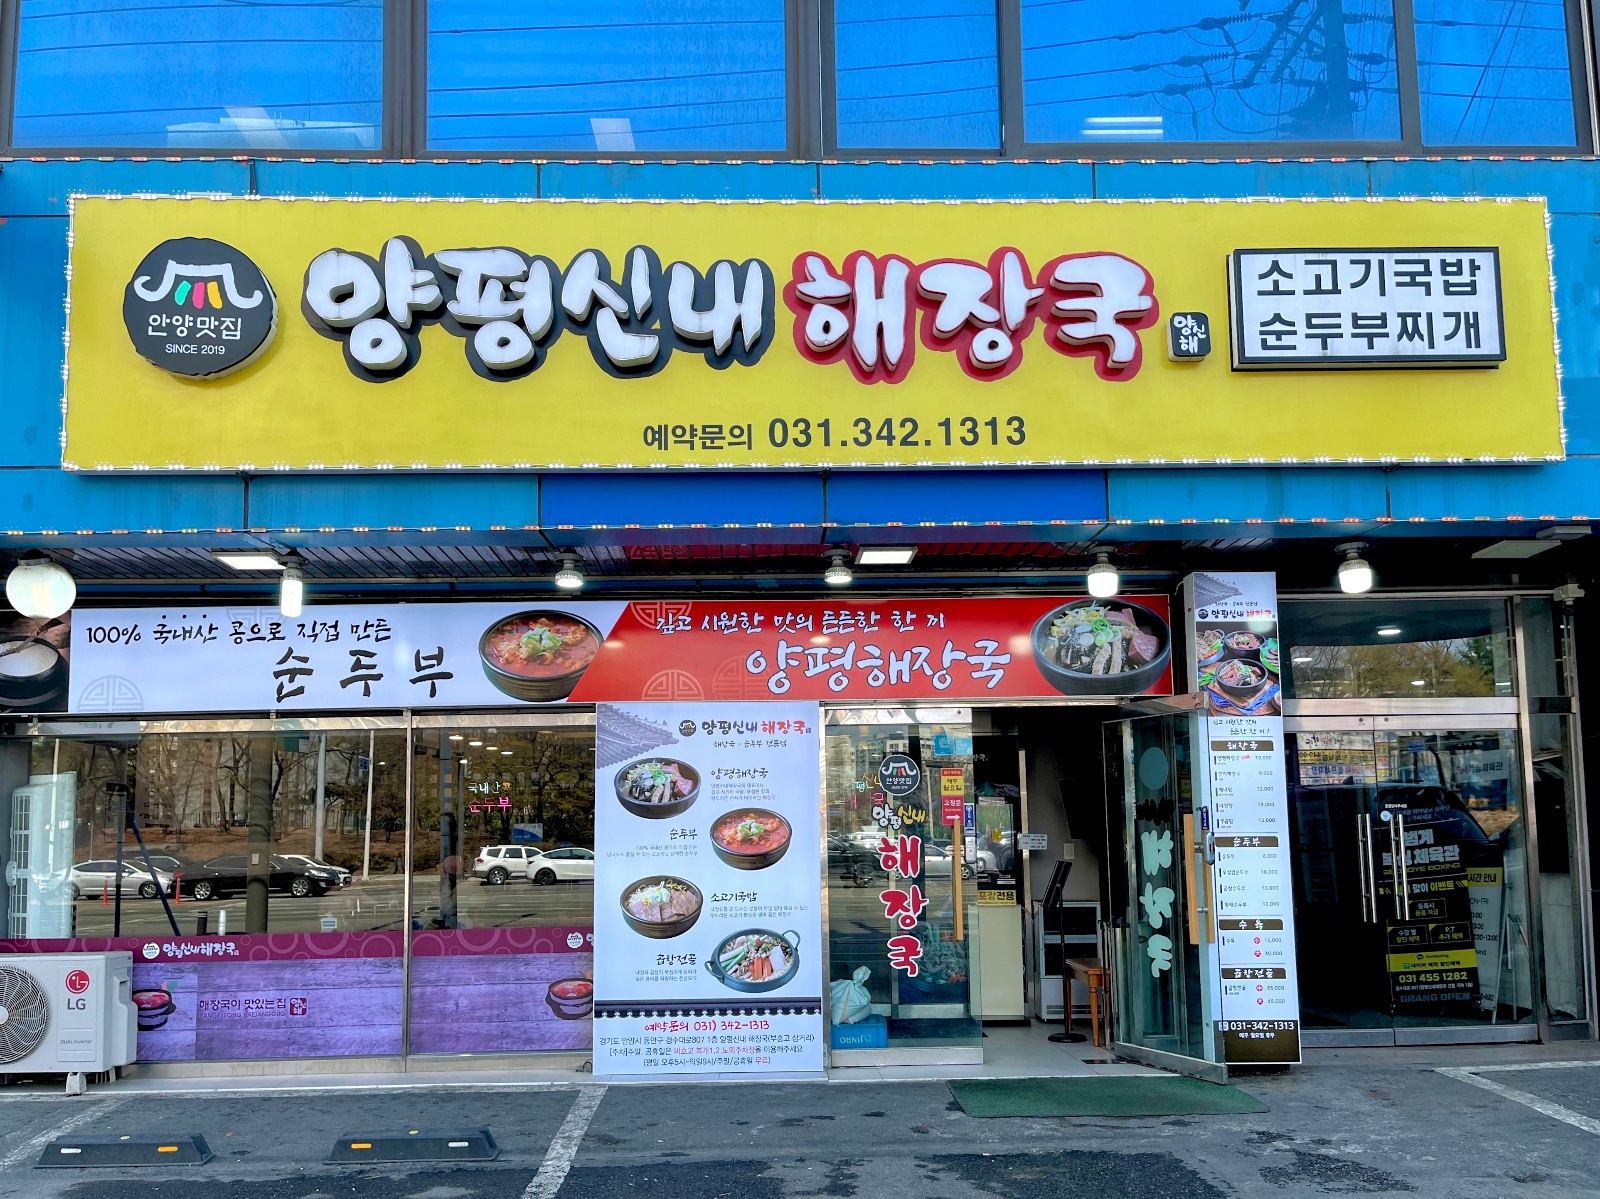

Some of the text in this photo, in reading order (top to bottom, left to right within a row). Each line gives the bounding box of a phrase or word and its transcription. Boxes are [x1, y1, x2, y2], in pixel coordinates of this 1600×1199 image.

[1257, 258, 1481, 297] 소고기국밥
[306, 237, 1153, 372] 양평신내 해장국
[147, 315, 242, 341] 안양맛집
[1258, 311, 1481, 350] 순두부찌개
[165, 344, 226, 354] SINCE 2019
[643, 416, 1027, 450] 예약문의 031.342.1313
[701, 612, 763, 634] 시원한
[773, 612, 814, 633] 맛의
[821, 611, 880, 633] 든든한
[890, 610, 916, 632] 한
[926, 611, 946, 629] 끼
[86, 616, 391, 644] 100% 국내산 콩으로 직접 만든
[746, 639, 1013, 695] 양평해장국
[701, 719, 758, 735] 양평신내
[761, 719, 806, 735] 해장국
[1227, 741, 1258, 750] 해장국
[711, 767, 768, 780] 양평해장국
[886, 777, 912, 785] 안양맛집
[468, 796, 513, 813] 순두부
[872, 803, 926, 830] 양평신내
[669, 828, 698, 841] 순두부
[1233, 836, 1261, 847] 순두부
[711, 892, 758, 902] 소고기국밥
[978, 890, 1015, 901] 포장전용
[656, 953, 697, 966] 곱창전골
[1234, 969, 1274, 979] 곱창전골
[1398, 971, 1468, 984] 031 455 1282
[1440, 991, 1471, 1002] OPEN
[67, 998, 87, 1011] LG
[644, 1020, 770, 1032] 예약문의 031) 342-1313
[1230, 1020, 1295, 1031] 031-342-1313
